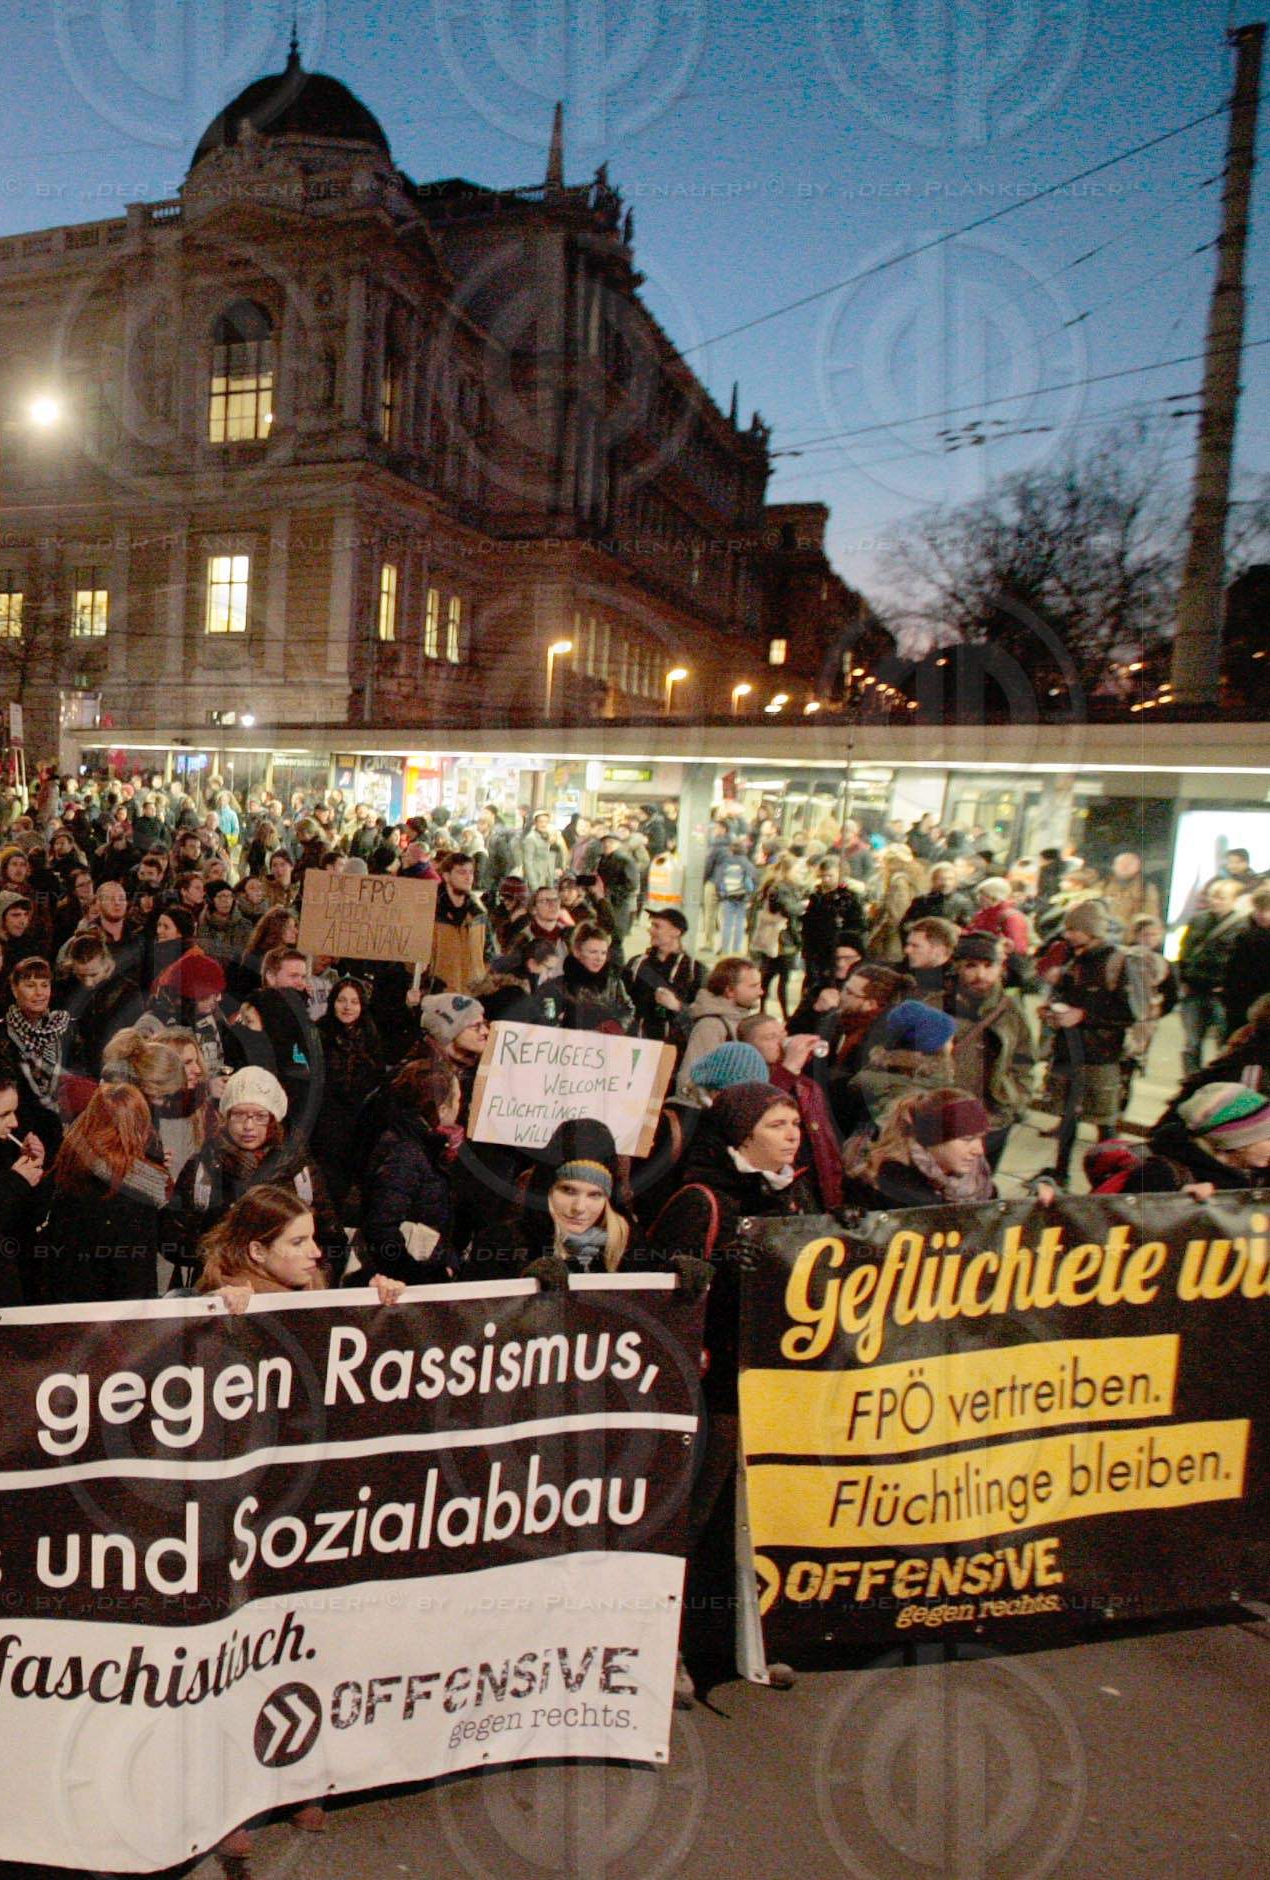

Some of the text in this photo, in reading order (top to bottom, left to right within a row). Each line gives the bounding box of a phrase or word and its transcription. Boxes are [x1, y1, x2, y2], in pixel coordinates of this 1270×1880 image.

[498, 1030, 606, 1069] REFUGEES
[543, 1074, 620, 1096] WELCOME
[780, 1212, 1270, 1364] Geflüchtete wi
[36, 1351, 292, 1456] gegen
[323, 1322, 660, 1407] Rassismus,
[847, 1355, 1162, 1441] FPÖ vertreiben.
[36, 1502, 199, 1595] und
[228, 1455, 648, 1581] Sozialabbau
[829, 1436, 1232, 1528] Flüchtlinge bleiben.
[896, 1602, 970, 1629] gegen
[976, 1594, 1062, 1622] rechts.
[449, 1703, 640, 1748] gegen rechts.
